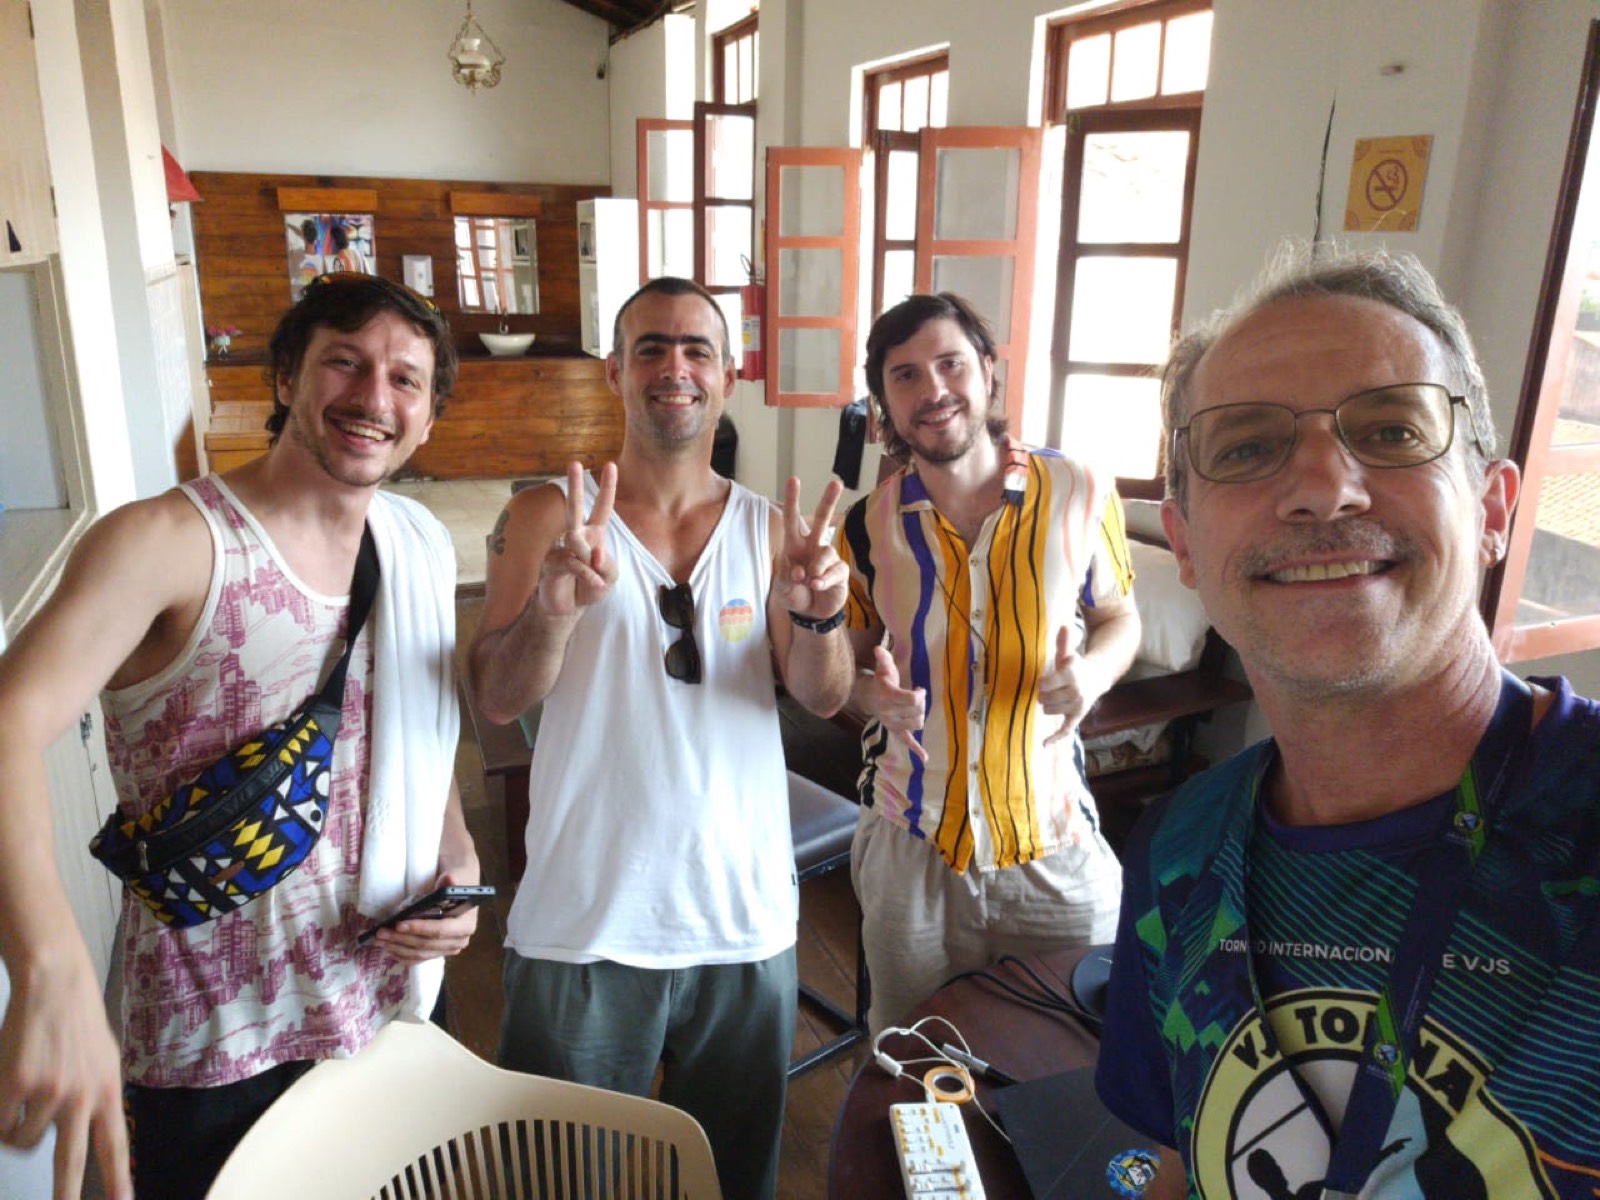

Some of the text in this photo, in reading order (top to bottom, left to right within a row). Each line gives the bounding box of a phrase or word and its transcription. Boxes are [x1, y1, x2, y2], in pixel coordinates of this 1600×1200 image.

[1219, 938, 1511, 975] TORNO INTERNACION E VJS
[1294, 1005, 1475, 1114] TONA
